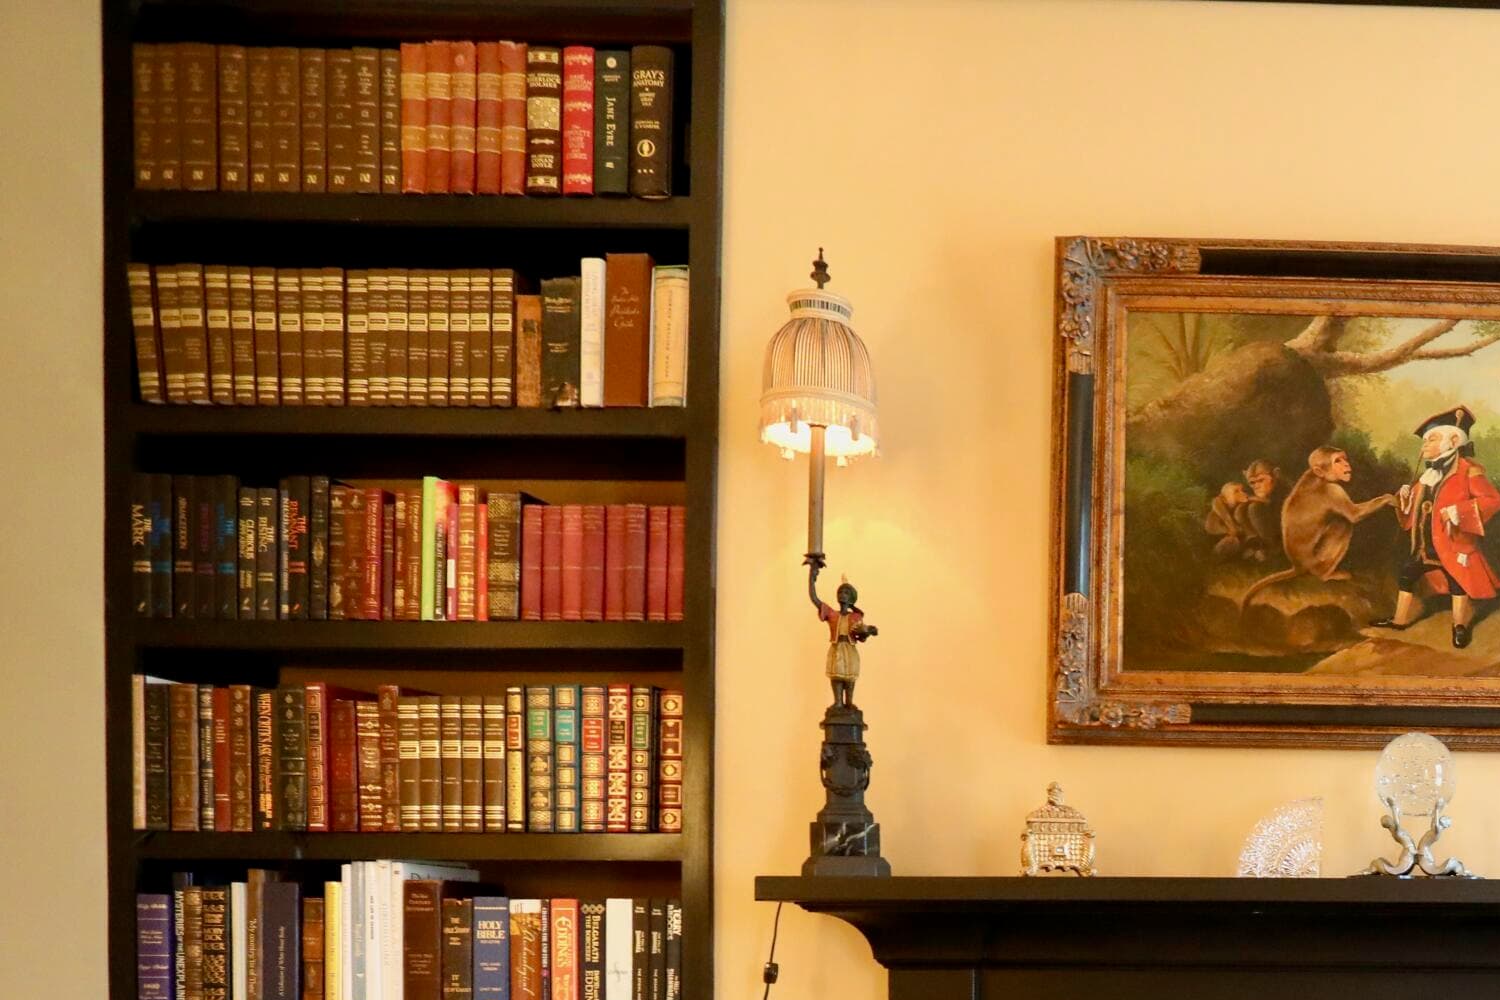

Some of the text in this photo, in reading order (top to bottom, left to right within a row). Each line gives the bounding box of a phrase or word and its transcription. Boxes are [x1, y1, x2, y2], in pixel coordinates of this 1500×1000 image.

[633, 69, 664, 80] GRAY'S
[633, 79, 664, 89] ANATOMY
[606, 96, 616, 147] JANE EYRE
[132, 504, 145, 546] MARK
[144, 518, 152, 532] THE
[258, 516, 268, 553] RISING
[290, 500, 299, 551] REMNANT
[298, 517, 306, 534] THE
[258, 693, 272, 715] WHEN
[258, 716, 272, 742] CRITICS
[258, 743, 272, 758] ASK
[175, 890, 185, 936] MYSTERIES
[478, 920, 503, 930] HOLY
[584, 915, 592, 926] THE
[673, 908, 682, 936] TERRY
[476, 930, 506, 940] BIBLE
[554, 916, 573, 968] EDDINGS
[592, 914, 602, 964] BELGARATH
[515, 927, 537, 997] Archaeological
[666, 968, 675, 1000] SHANNARA
